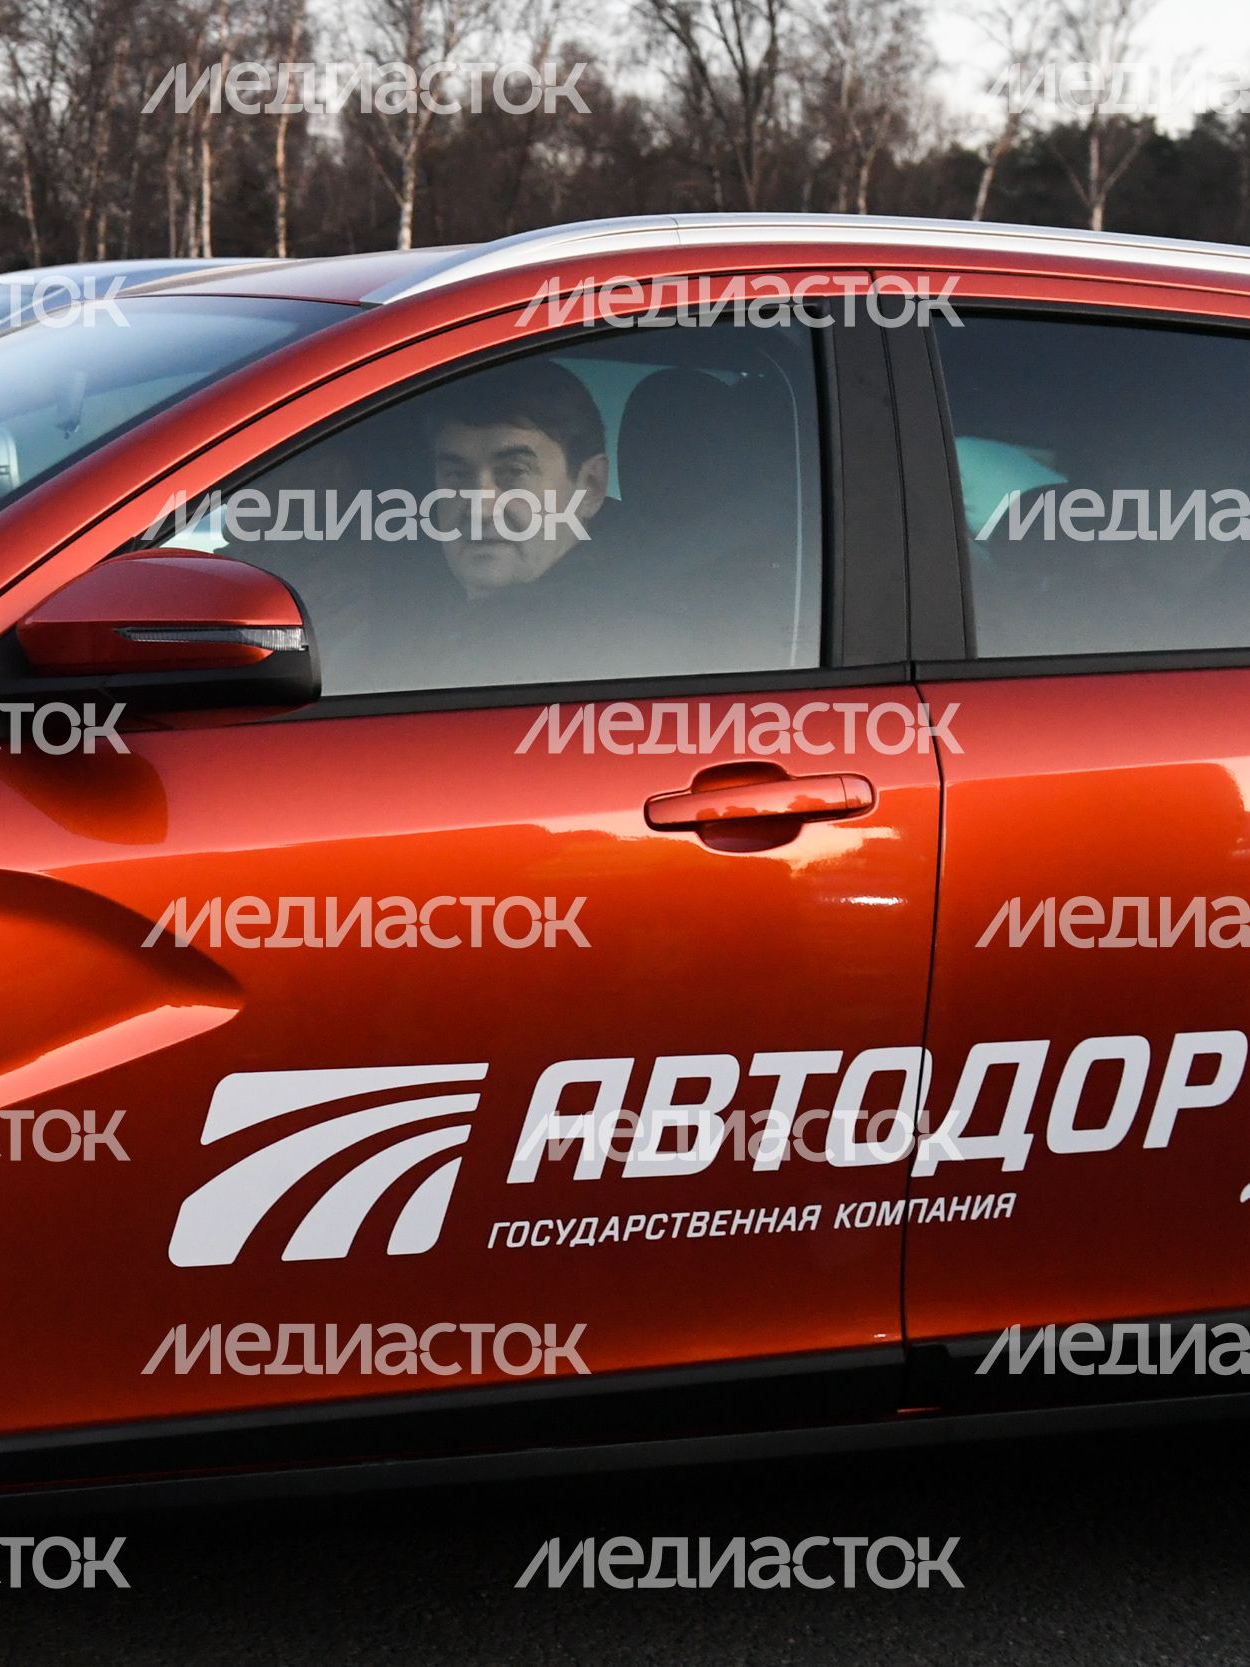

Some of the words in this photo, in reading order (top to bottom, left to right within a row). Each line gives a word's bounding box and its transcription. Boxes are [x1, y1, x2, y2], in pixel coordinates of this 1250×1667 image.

[506, 1029, 1249, 1184] АВТОДОР
[487, 1204, 822, 1249] ГОСУДАРСТВЕННАЯ
[833, 1192, 1017, 1230] КОМПАНИЯ
